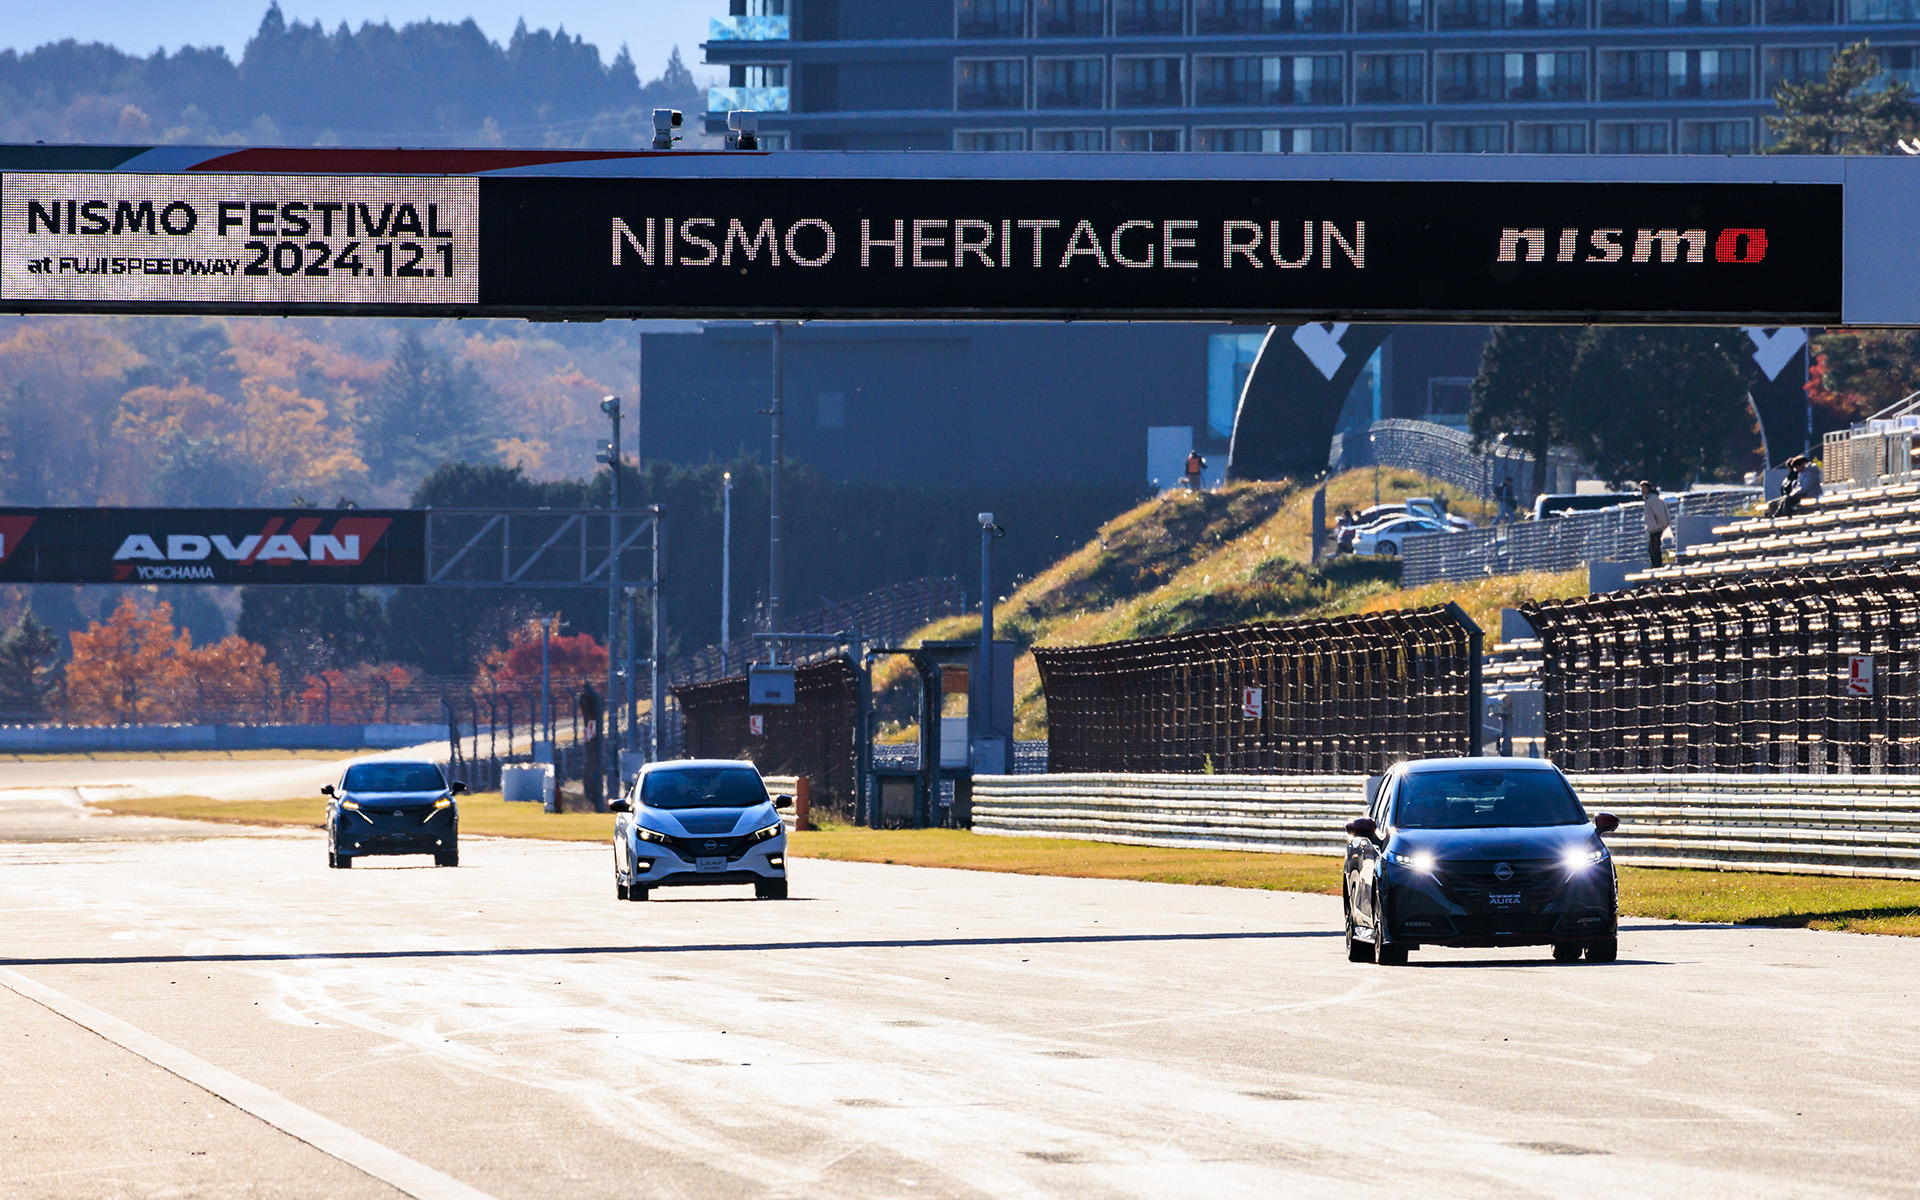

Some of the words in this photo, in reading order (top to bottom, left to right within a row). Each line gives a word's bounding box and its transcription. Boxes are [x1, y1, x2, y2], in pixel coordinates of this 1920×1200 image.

[28, 200, 198, 236] NISMO
[217, 201, 453, 239] FESTIVAL
[27, 256, 53, 275] at
[59, 257, 108, 275] FUJI
[111, 257, 240, 276] SPEEDWAY
[243, 241, 453, 278] 2024.12.1
[612, 217, 836, 267] NISMO
[861, 219, 1199, 269] HERITAGE
[1223, 220, 1365, 269] RUN
[112, 533, 360, 561] ADVAN
[136, 565, 215, 580] YOKOHAMA
